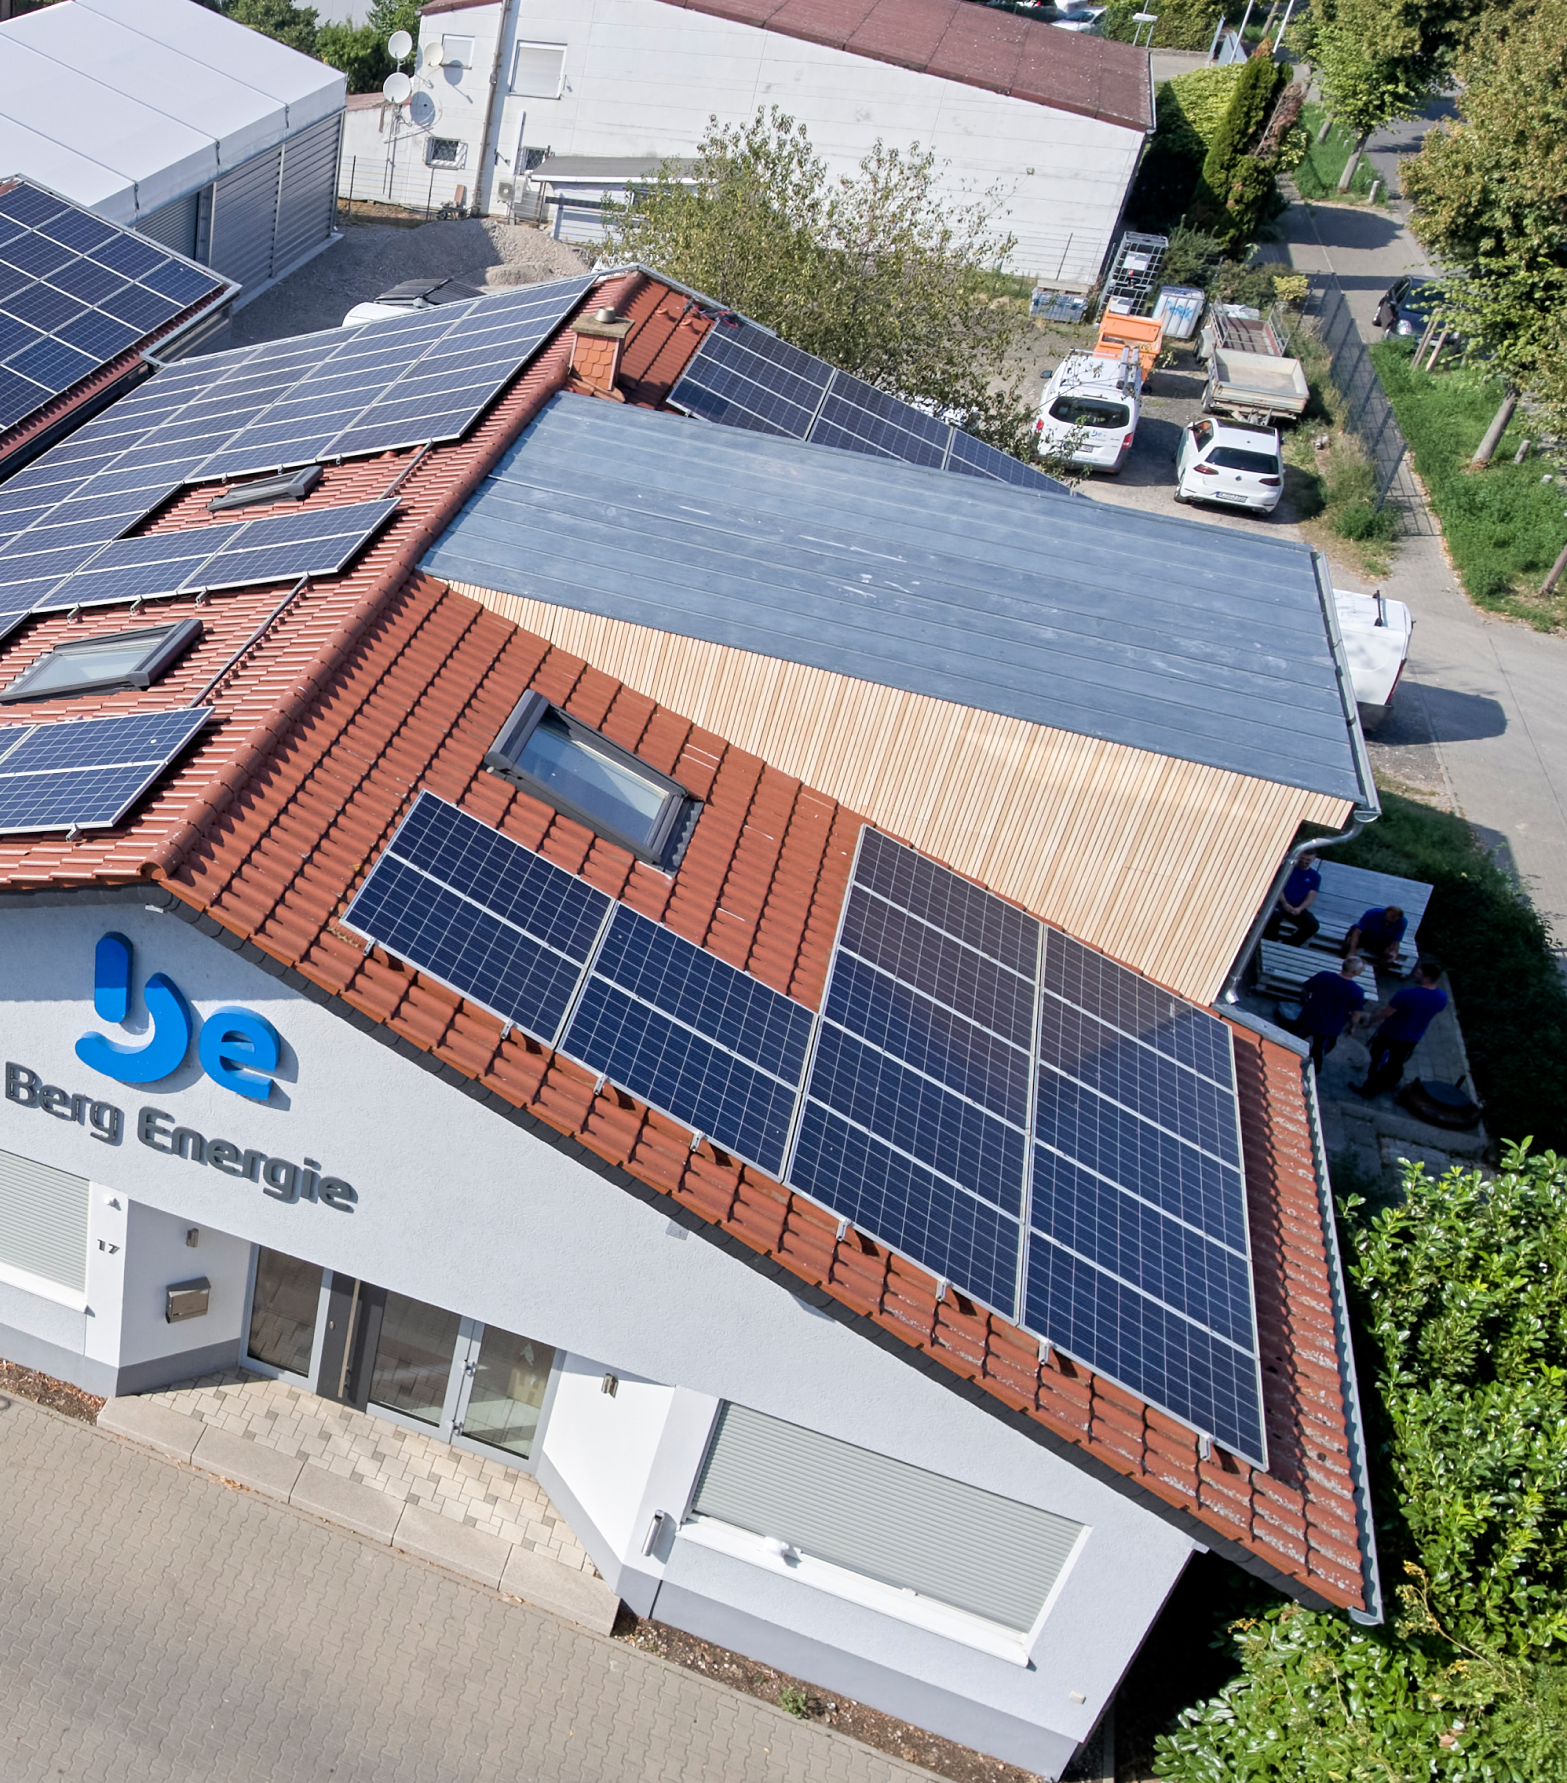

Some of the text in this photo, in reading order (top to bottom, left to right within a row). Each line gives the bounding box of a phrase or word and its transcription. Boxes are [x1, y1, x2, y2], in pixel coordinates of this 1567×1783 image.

[5, 1061, 358, 1213] Berg Energie
[97, 1239, 120, 1255] 17
